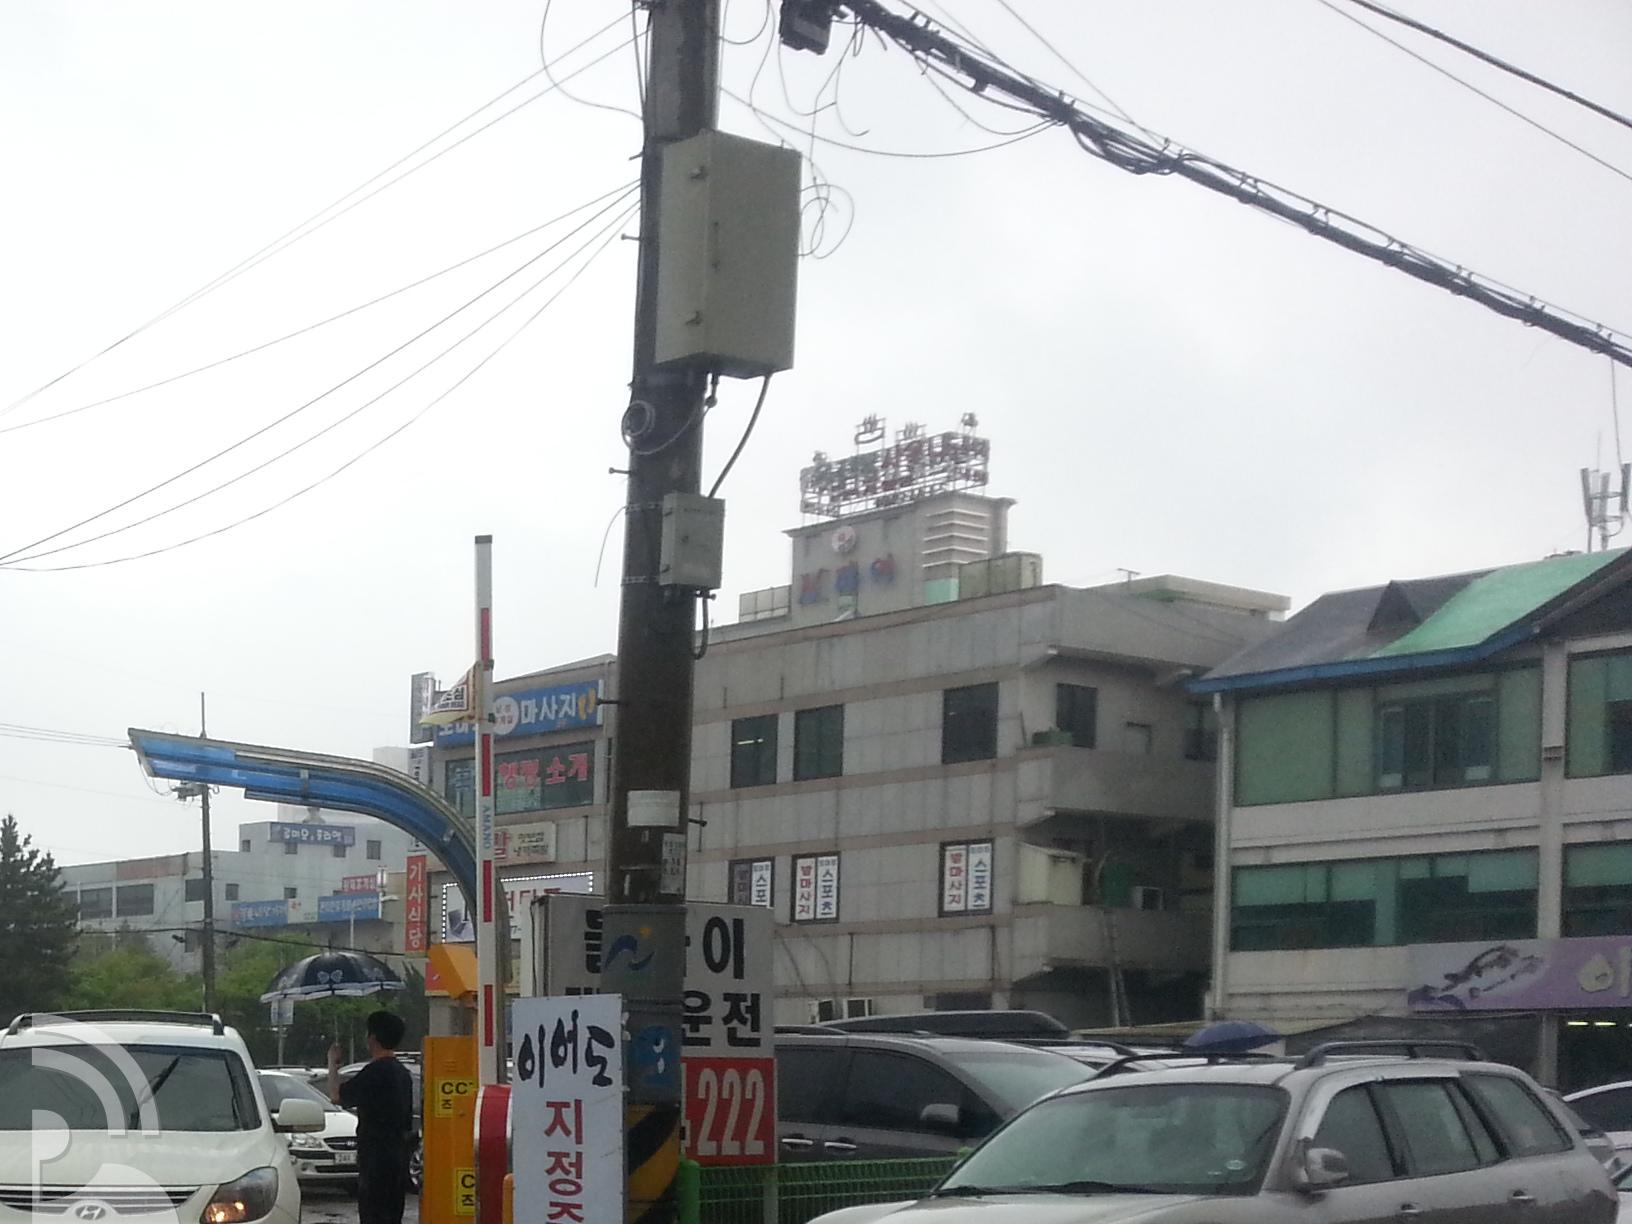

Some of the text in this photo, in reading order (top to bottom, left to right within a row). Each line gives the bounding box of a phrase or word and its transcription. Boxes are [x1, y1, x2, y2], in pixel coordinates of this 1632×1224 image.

[520, 692, 577, 724] 마사지
[482, 805, 493, 850] AMANO
[755, 874, 768, 904] 스포
[518, 1009, 616, 1089] 이어도
[441, 1081, 474, 1095] CC
